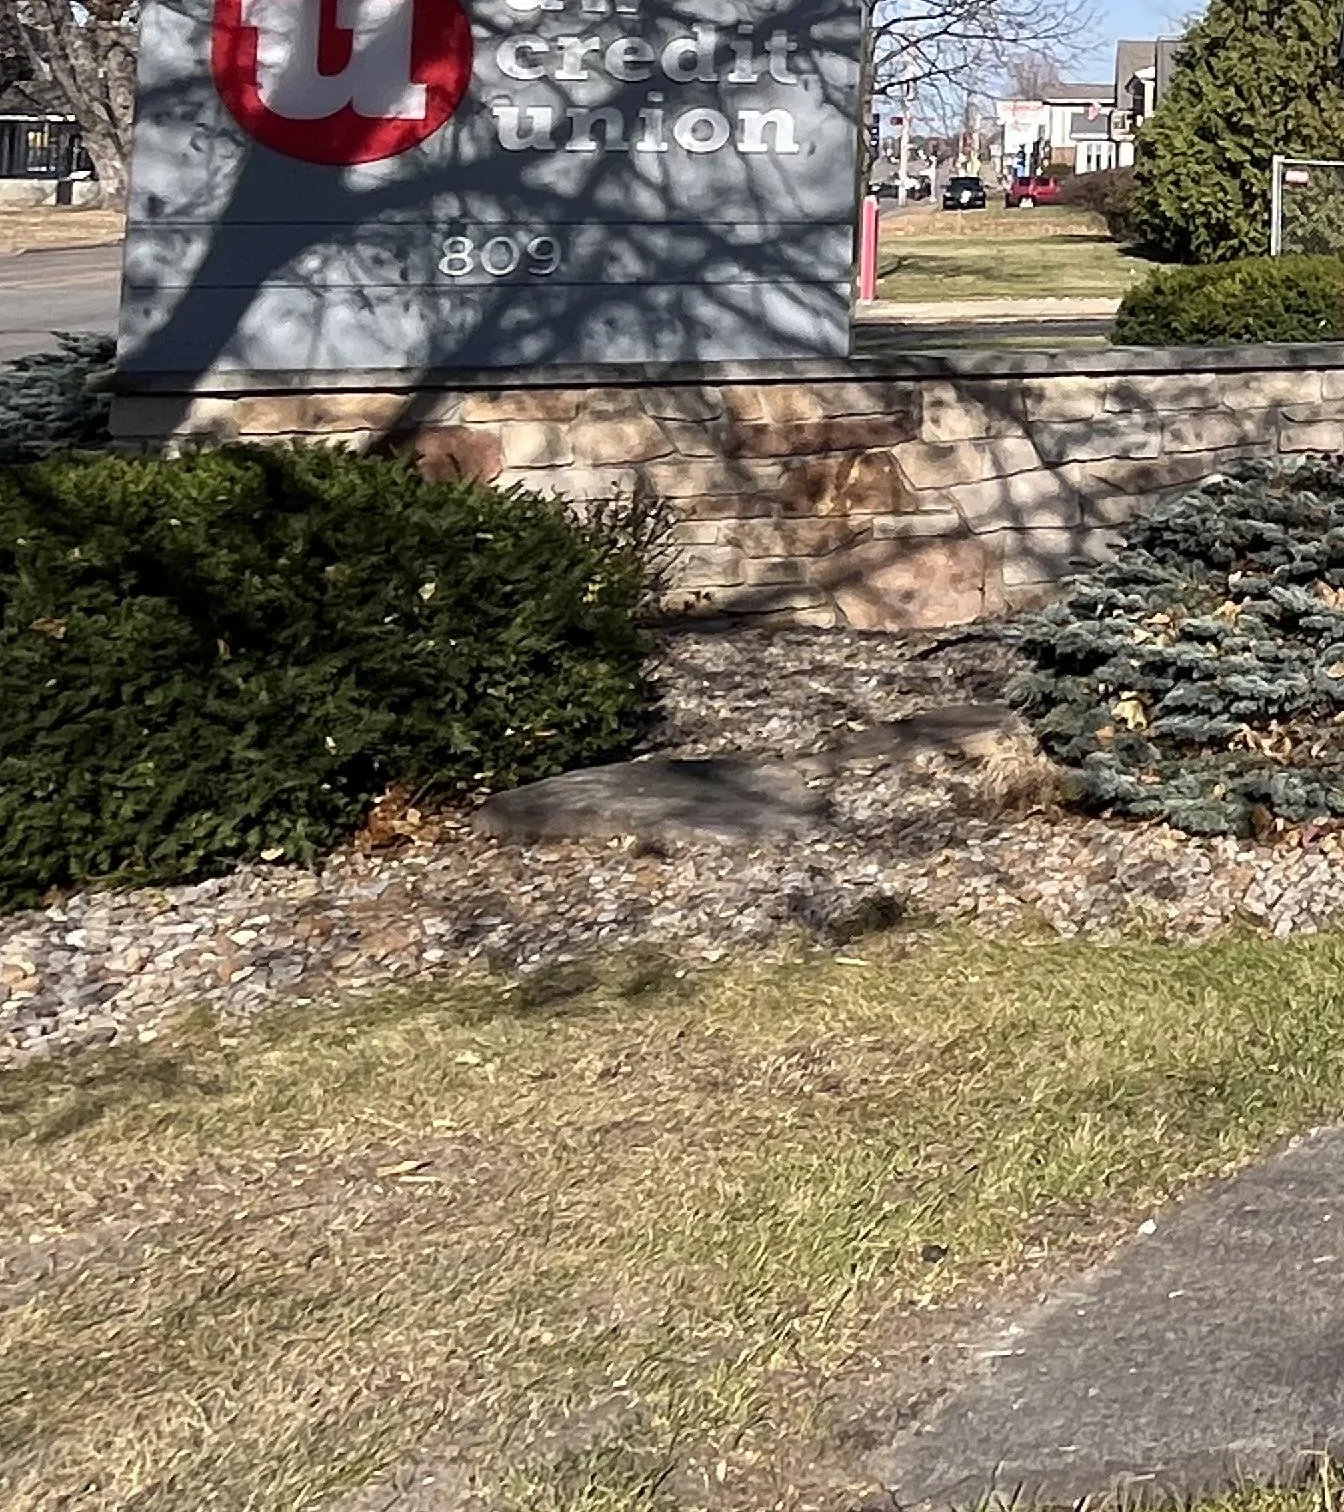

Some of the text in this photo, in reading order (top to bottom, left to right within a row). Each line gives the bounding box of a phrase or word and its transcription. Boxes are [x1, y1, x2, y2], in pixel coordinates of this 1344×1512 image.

[496, 24, 798, 84] credit
[493, 91, 799, 154] union
[437, 236, 563, 277] 809
